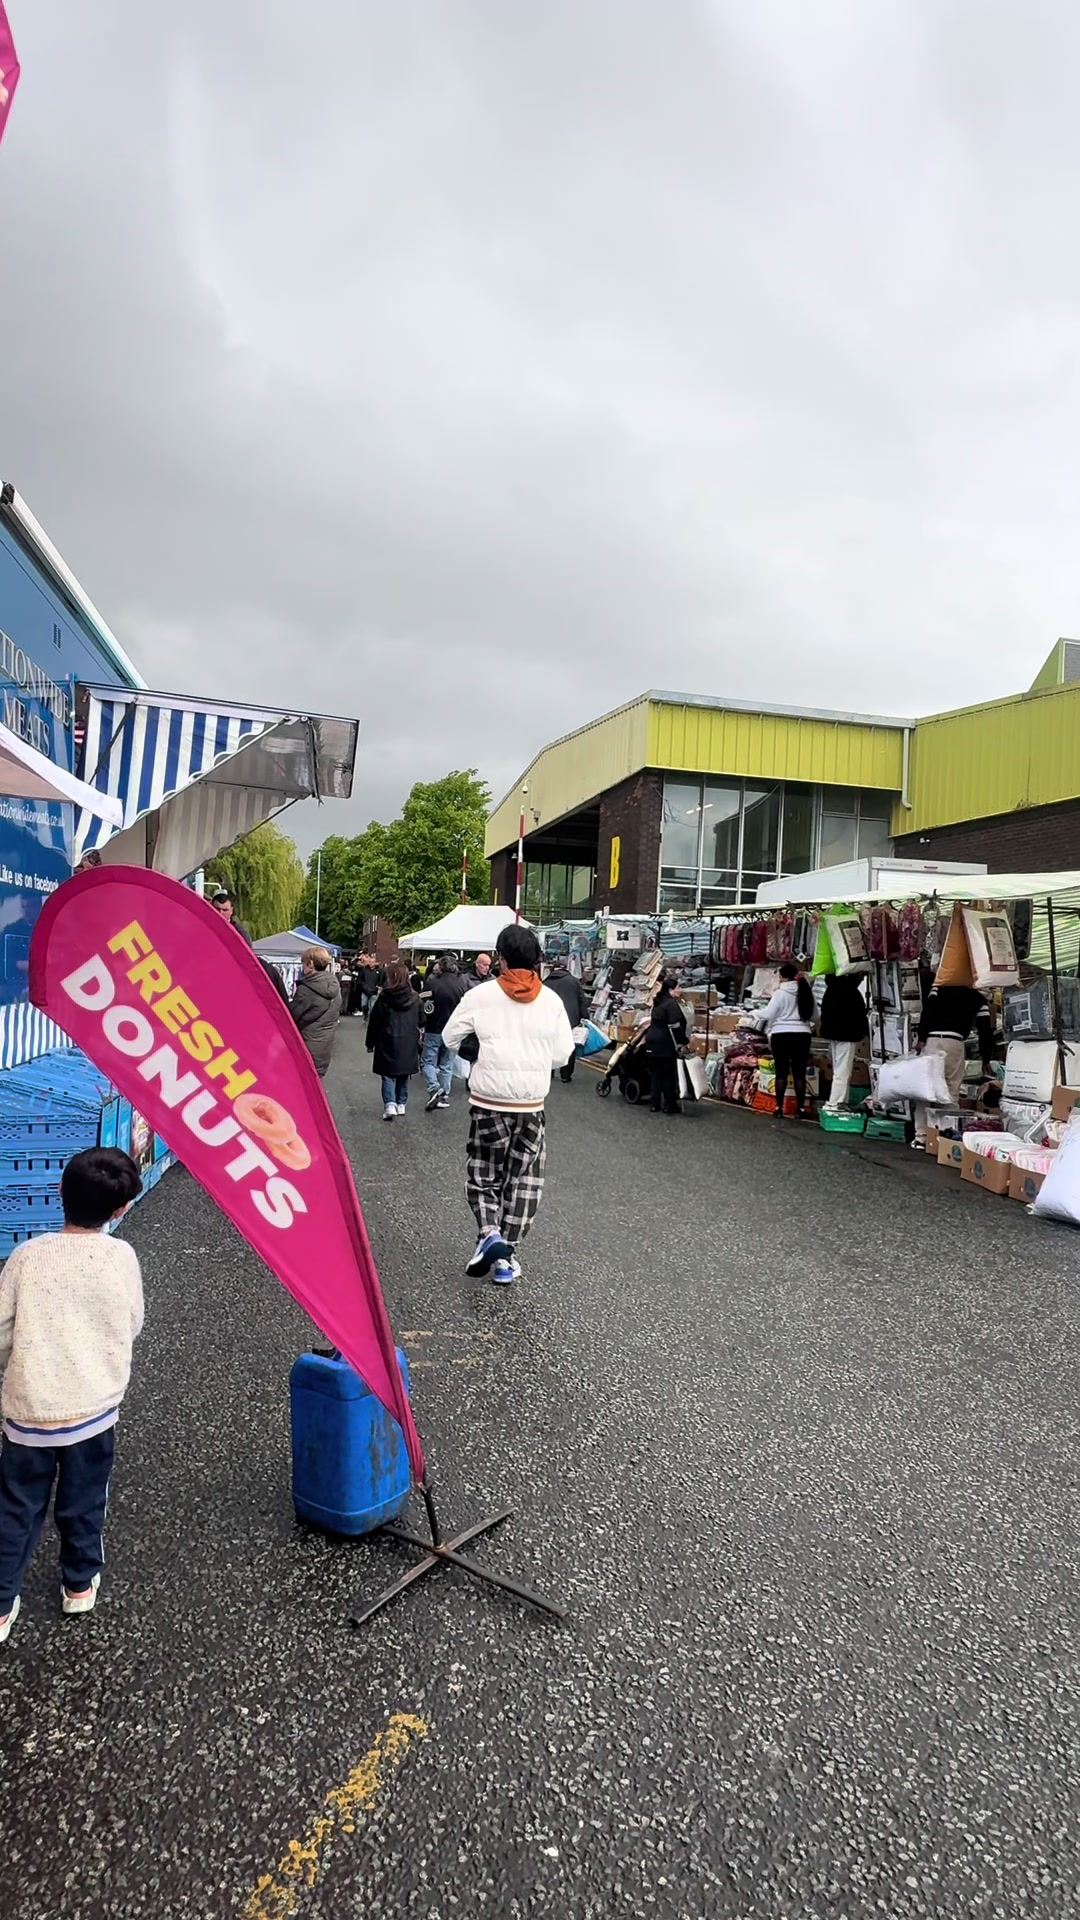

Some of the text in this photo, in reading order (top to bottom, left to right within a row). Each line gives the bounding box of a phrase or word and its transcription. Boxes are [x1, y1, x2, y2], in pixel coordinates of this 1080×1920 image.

[2, 687, 50, 756] MEATS
[0, 863, 13, 884] Like
[14, 872, 23, 887] us
[24, 874, 33, 889] on
[609, 836, 620, 889] B
[106, 919, 257, 1100] FRESH
[60, 953, 307, 1229] DONUTS
